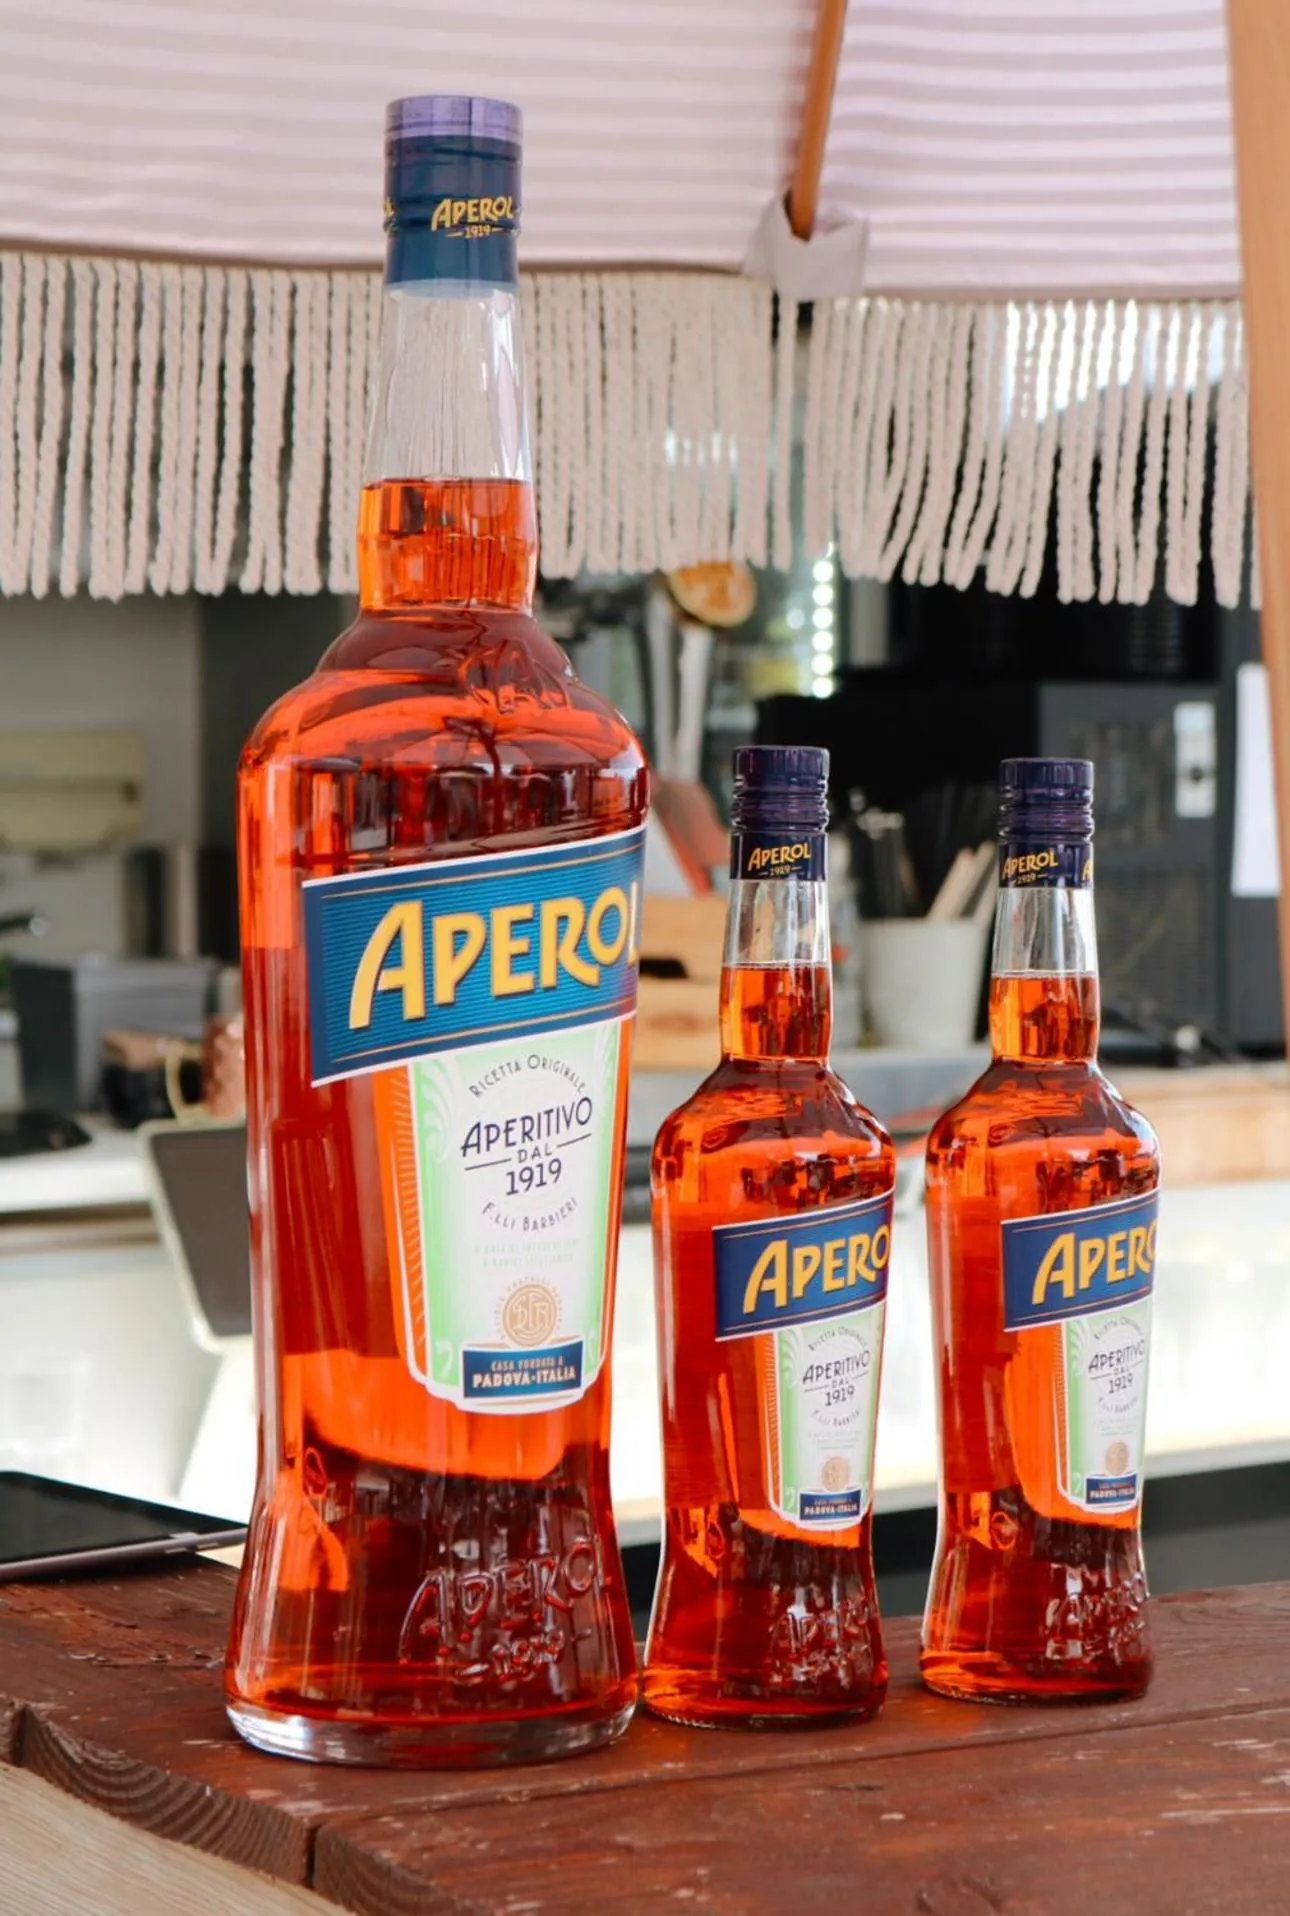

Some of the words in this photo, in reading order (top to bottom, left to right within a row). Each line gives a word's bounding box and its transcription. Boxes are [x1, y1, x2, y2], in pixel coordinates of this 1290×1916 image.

[431, 196, 514, 231] APEROL
[465, 225, 490, 238] 1919
[748, 842, 812, 871] APEROL
[1002, 847, 1059, 879] APEROL
[468, 1060, 522, 1098] RICETTA
[527, 1054, 586, 1095] ORIGINALE
[461, 1096, 593, 1157] APERITIVO
[517, 1144, 553, 1163] DAL
[505, 1158, 562, 1196] 1919
[522, 1197, 578, 1232] BARBIERI
[803, 1350, 870, 1385] APERITIVO
[1109, 1373, 1133, 1394] 1919
[825, 1385, 855, 1407] 1919
